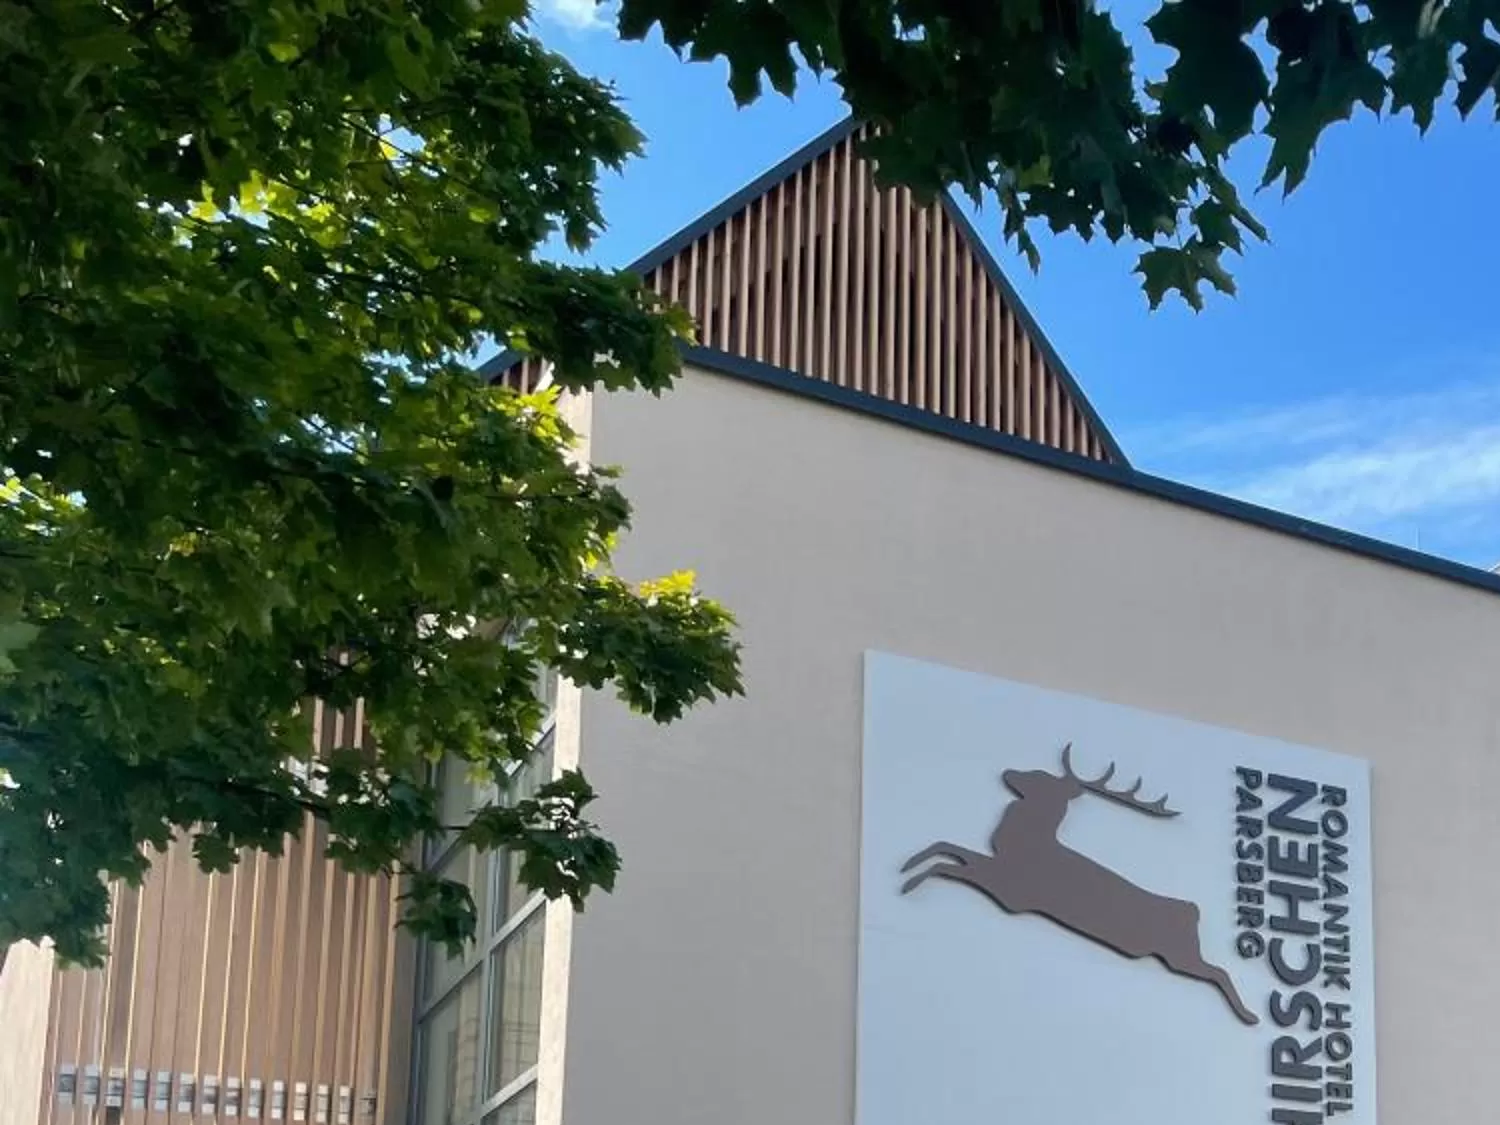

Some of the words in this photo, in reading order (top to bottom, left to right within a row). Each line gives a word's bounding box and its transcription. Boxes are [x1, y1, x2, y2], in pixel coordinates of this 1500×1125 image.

[1235, 766, 1265, 959] PARSBERG
[1320, 785, 1351, 991] ROMANTIK
[1325, 1003, 1353, 1117] HOTEL
